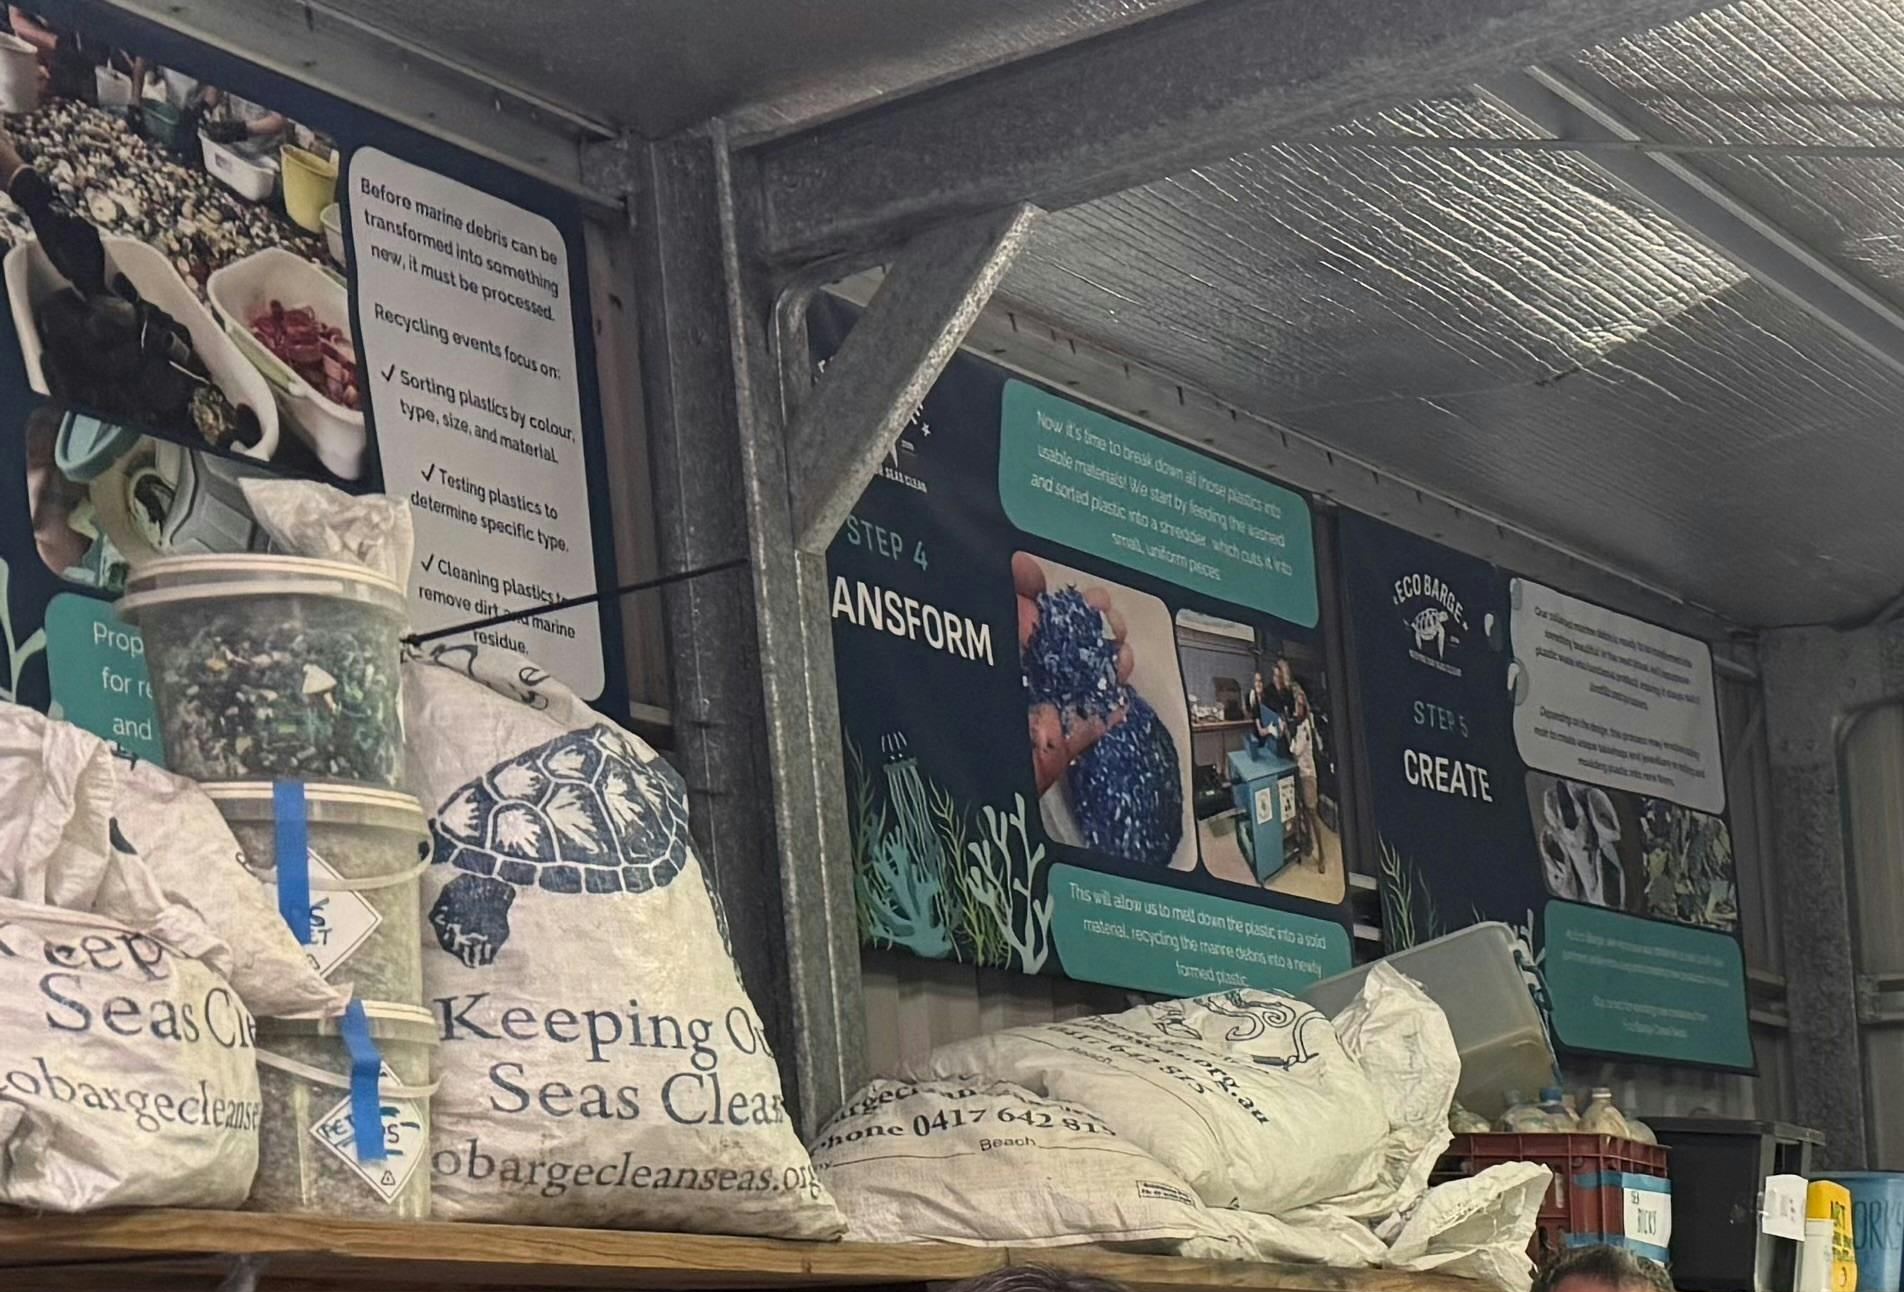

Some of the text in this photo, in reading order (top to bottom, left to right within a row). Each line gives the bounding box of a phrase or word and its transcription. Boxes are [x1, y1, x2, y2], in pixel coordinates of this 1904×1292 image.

[361, 177, 558, 266] Before marine debris can be
[364, 208, 559, 299] transformed into something
[371, 244, 555, 323] new, it must be processed.
[374, 302, 561, 380] Recycling events focus on:
[400, 370, 576, 443] Sorting plastics by colour,
[400, 398, 439, 426] type,
[442, 411, 472, 437] size,
[474, 423, 497, 445] and
[1037, 411, 1064, 433] Now
[1109, 440, 1121, 456] to
[439, 467, 558, 521] Testing plastics to
[1037, 444, 1072, 470] usable
[1129, 476, 1149, 498] We
[1150, 485, 1172, 505] start
[1174, 496, 1187, 516] by
[1189, 498, 1228, 532] feeding
[1229, 513, 1247, 533] the
[411, 491, 569, 553] determine specific type.
[846, 513, 929, 572] STEP 4
[1031, 472, 1053, 493] and
[1055, 482, 1090, 508] sorted
[1150, 519, 1158, 532] a
[1241, 548, 1264, 568] cuts
[438, 559, 554, 605] Cleaning plastics
[1146, 543, 1188, 569] uniform
[418, 587, 472, 611] remove
[475, 600, 499, 618] dirt
[532, 617, 576, 640] marine
[1394, 573, 1465, 625] ECO BARGE
[102, 666, 132, 696] for
[112, 717, 153, 741] and
[1413, 700, 1456, 732] STEP
[1403, 748, 1494, 803] CREATE
[1069, 882, 1092, 902] This
[1114, 893, 1142, 913] allow
[1144, 901, 1158, 917] us
[1158, 903, 1171, 919] to
[1198, 911, 1226, 930] down
[1227, 916, 1244, 934] the
[1131, 928, 1180, 953] recycling
[1180, 935, 1199, 952] the
[1175, 960, 1216, 983] formed
[38, 972, 201, 1043] Seas
[433, 992, 719, 1072] Keeping
[488, 1061, 641, 1122] Seas
[912, 1106, 1054, 1138] 0417 642
[979, 1137, 1038, 1153] Beach
